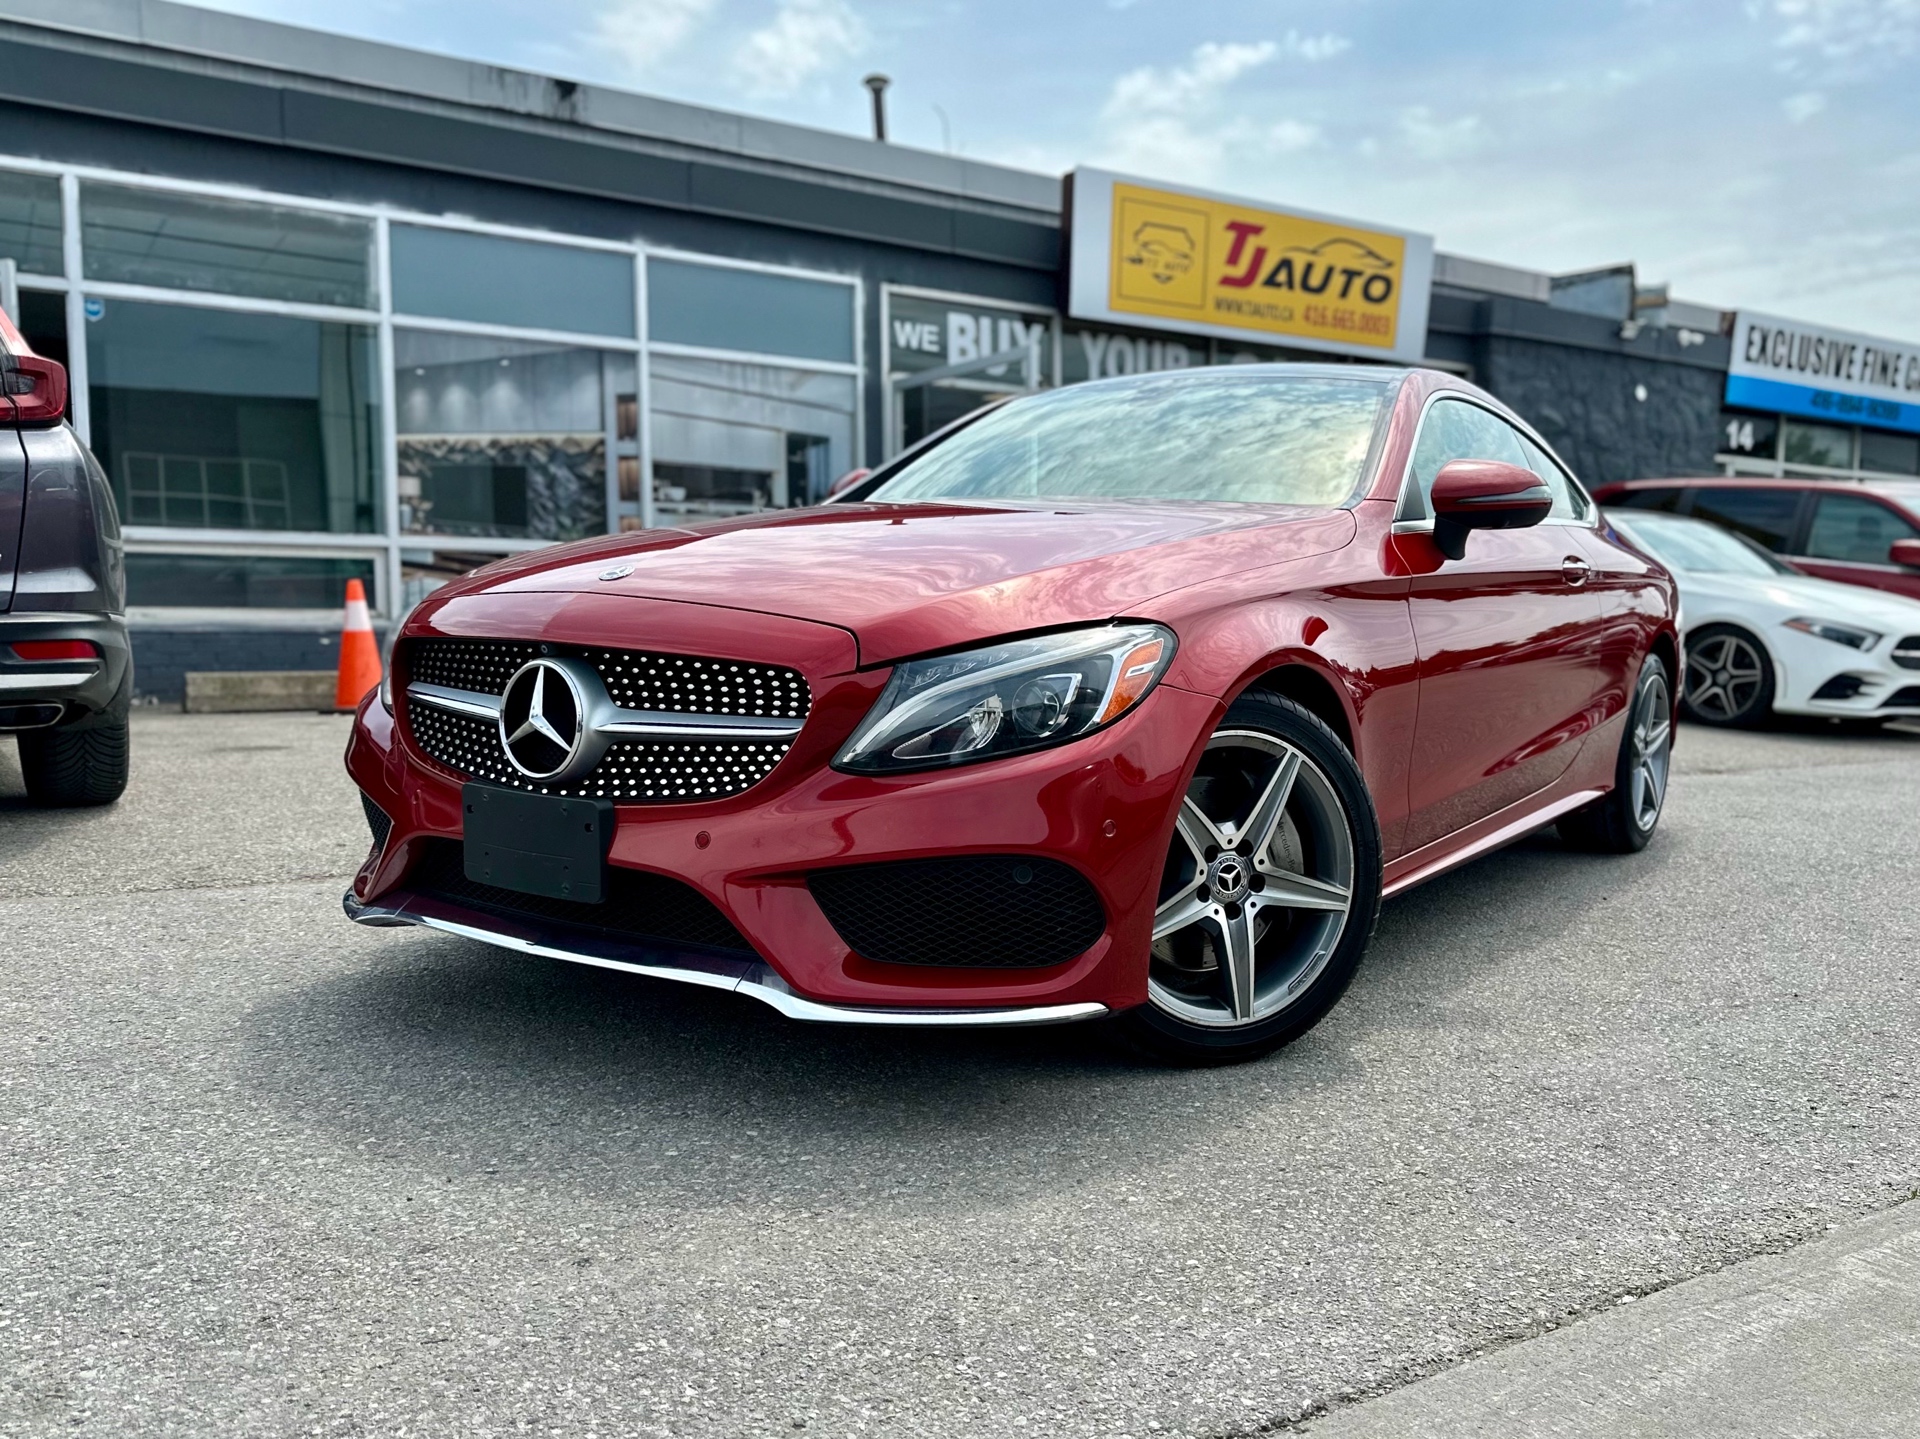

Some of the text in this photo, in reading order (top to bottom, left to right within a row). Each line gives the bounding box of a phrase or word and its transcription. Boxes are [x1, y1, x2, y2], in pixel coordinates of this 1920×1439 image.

[1218, 219, 1393, 304] TJ AUTO
[893, 320, 941, 353] WE
[946, 311, 1045, 379] BUY
[1745, 324, 1857, 381] EXCLUSIVE
[1859, 347, 1902, 388] FINE
[1726, 419, 1755, 451] 14
